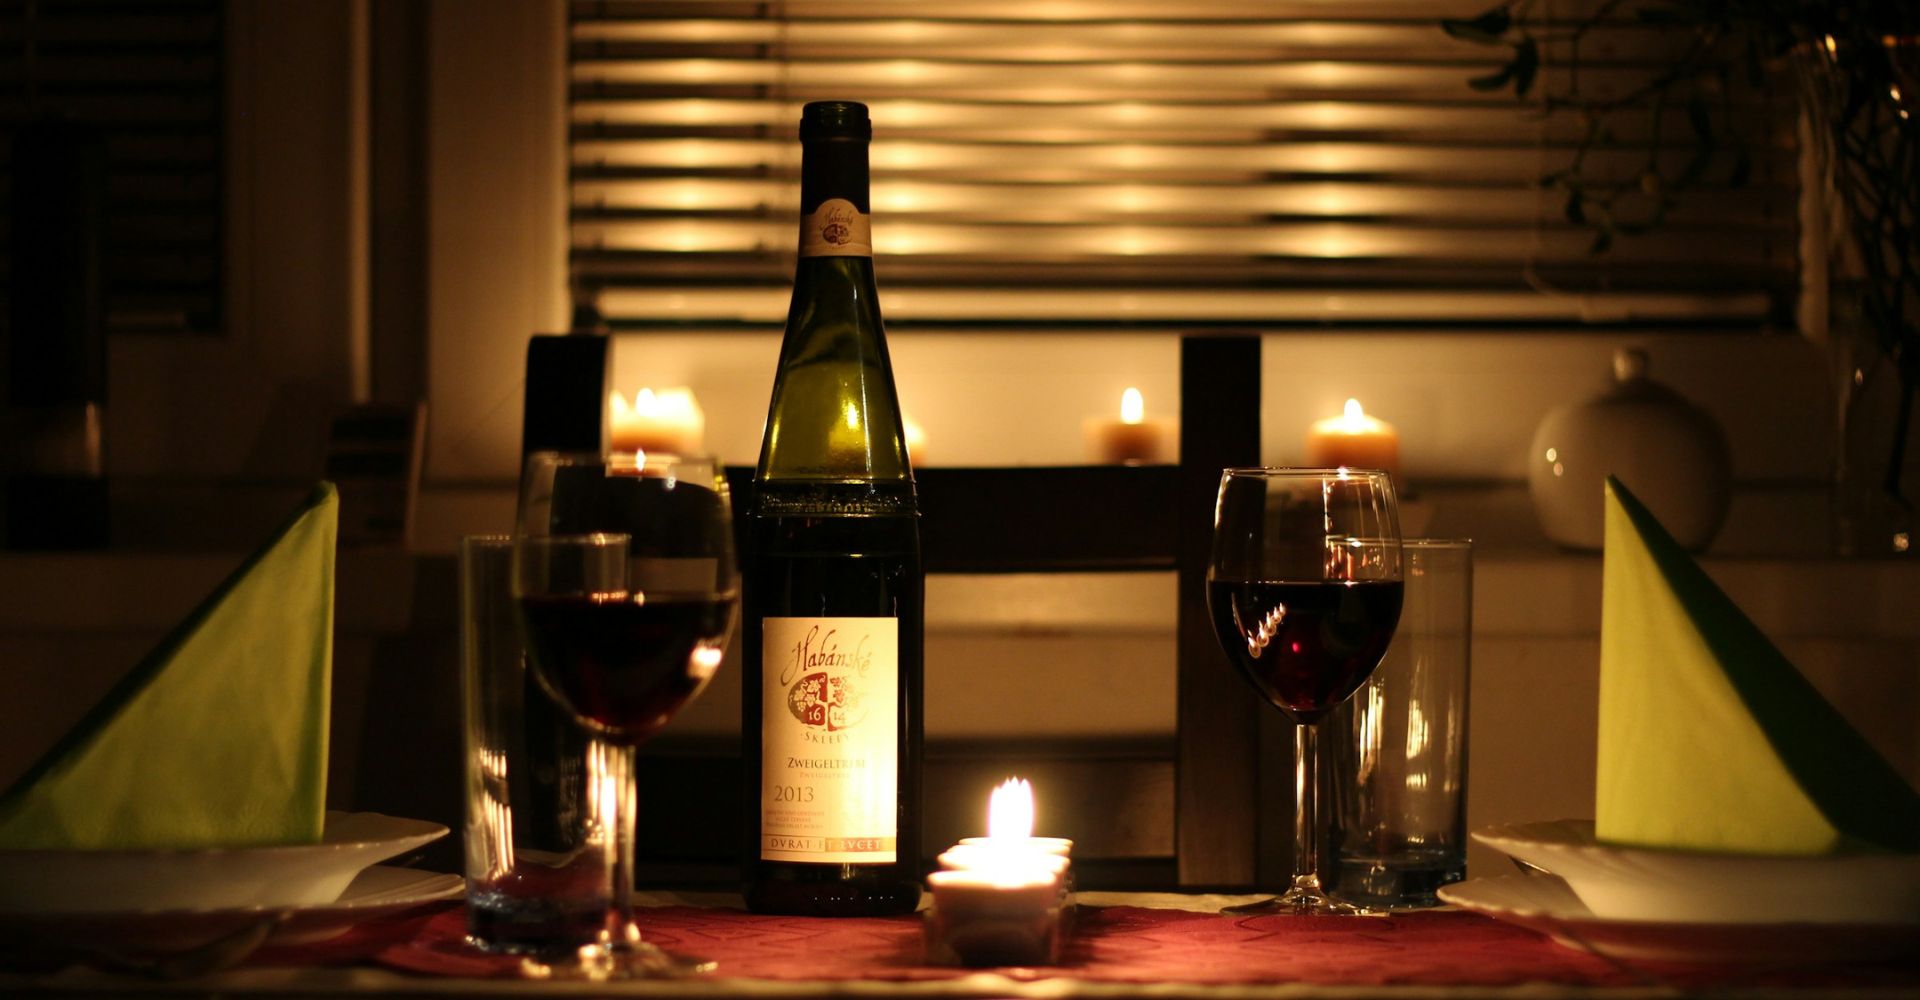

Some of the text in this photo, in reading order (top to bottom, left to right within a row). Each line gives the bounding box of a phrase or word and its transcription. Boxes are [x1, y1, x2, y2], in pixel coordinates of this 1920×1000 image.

[780, 624, 872, 687] Habánské
[808, 707, 822, 721] 16
[803, 731, 850, 745] SKLE
[774, 785, 814, 802] 2013
[770, 838, 810, 849] DVRAT
